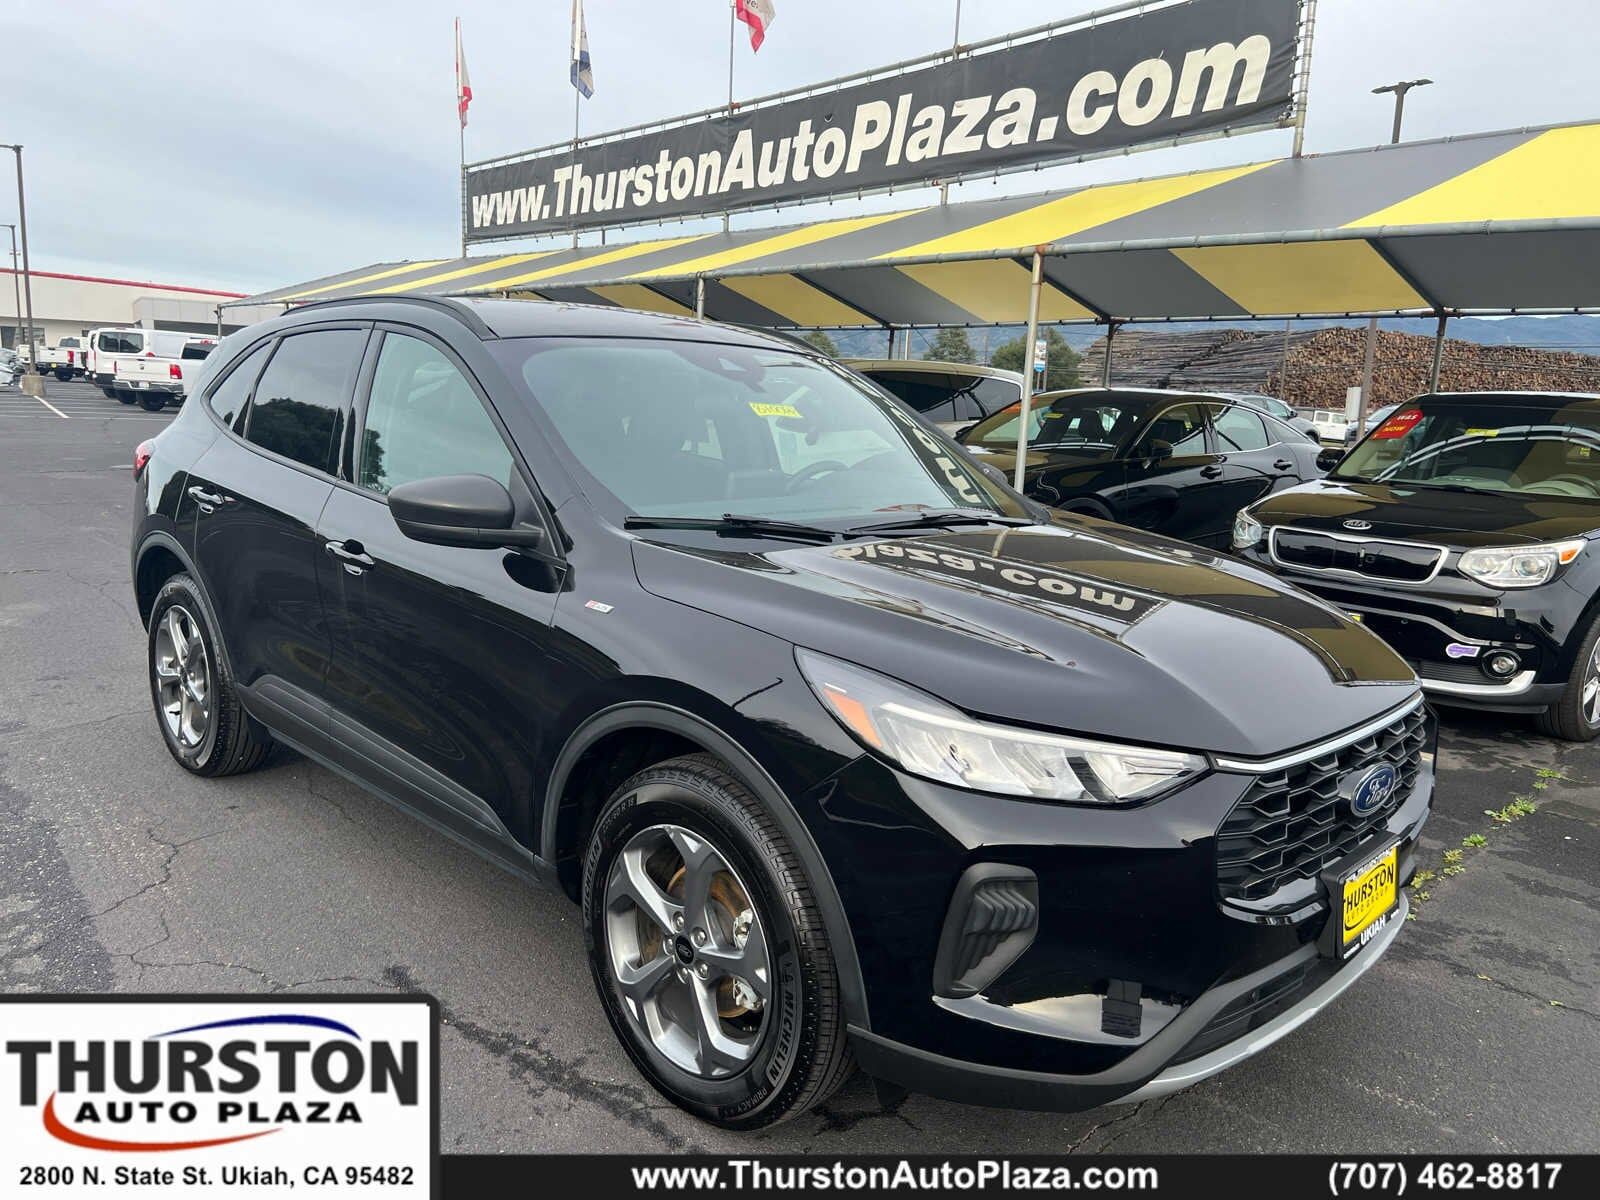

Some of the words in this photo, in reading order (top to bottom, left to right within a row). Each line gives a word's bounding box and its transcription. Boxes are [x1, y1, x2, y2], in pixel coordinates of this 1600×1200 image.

[472, 34, 1272, 229] www.ThurstonAutoPlaza.com
[1360, 914, 1387, 946] UKIAH
[769, 990, 795, 1081] MICHELIN
